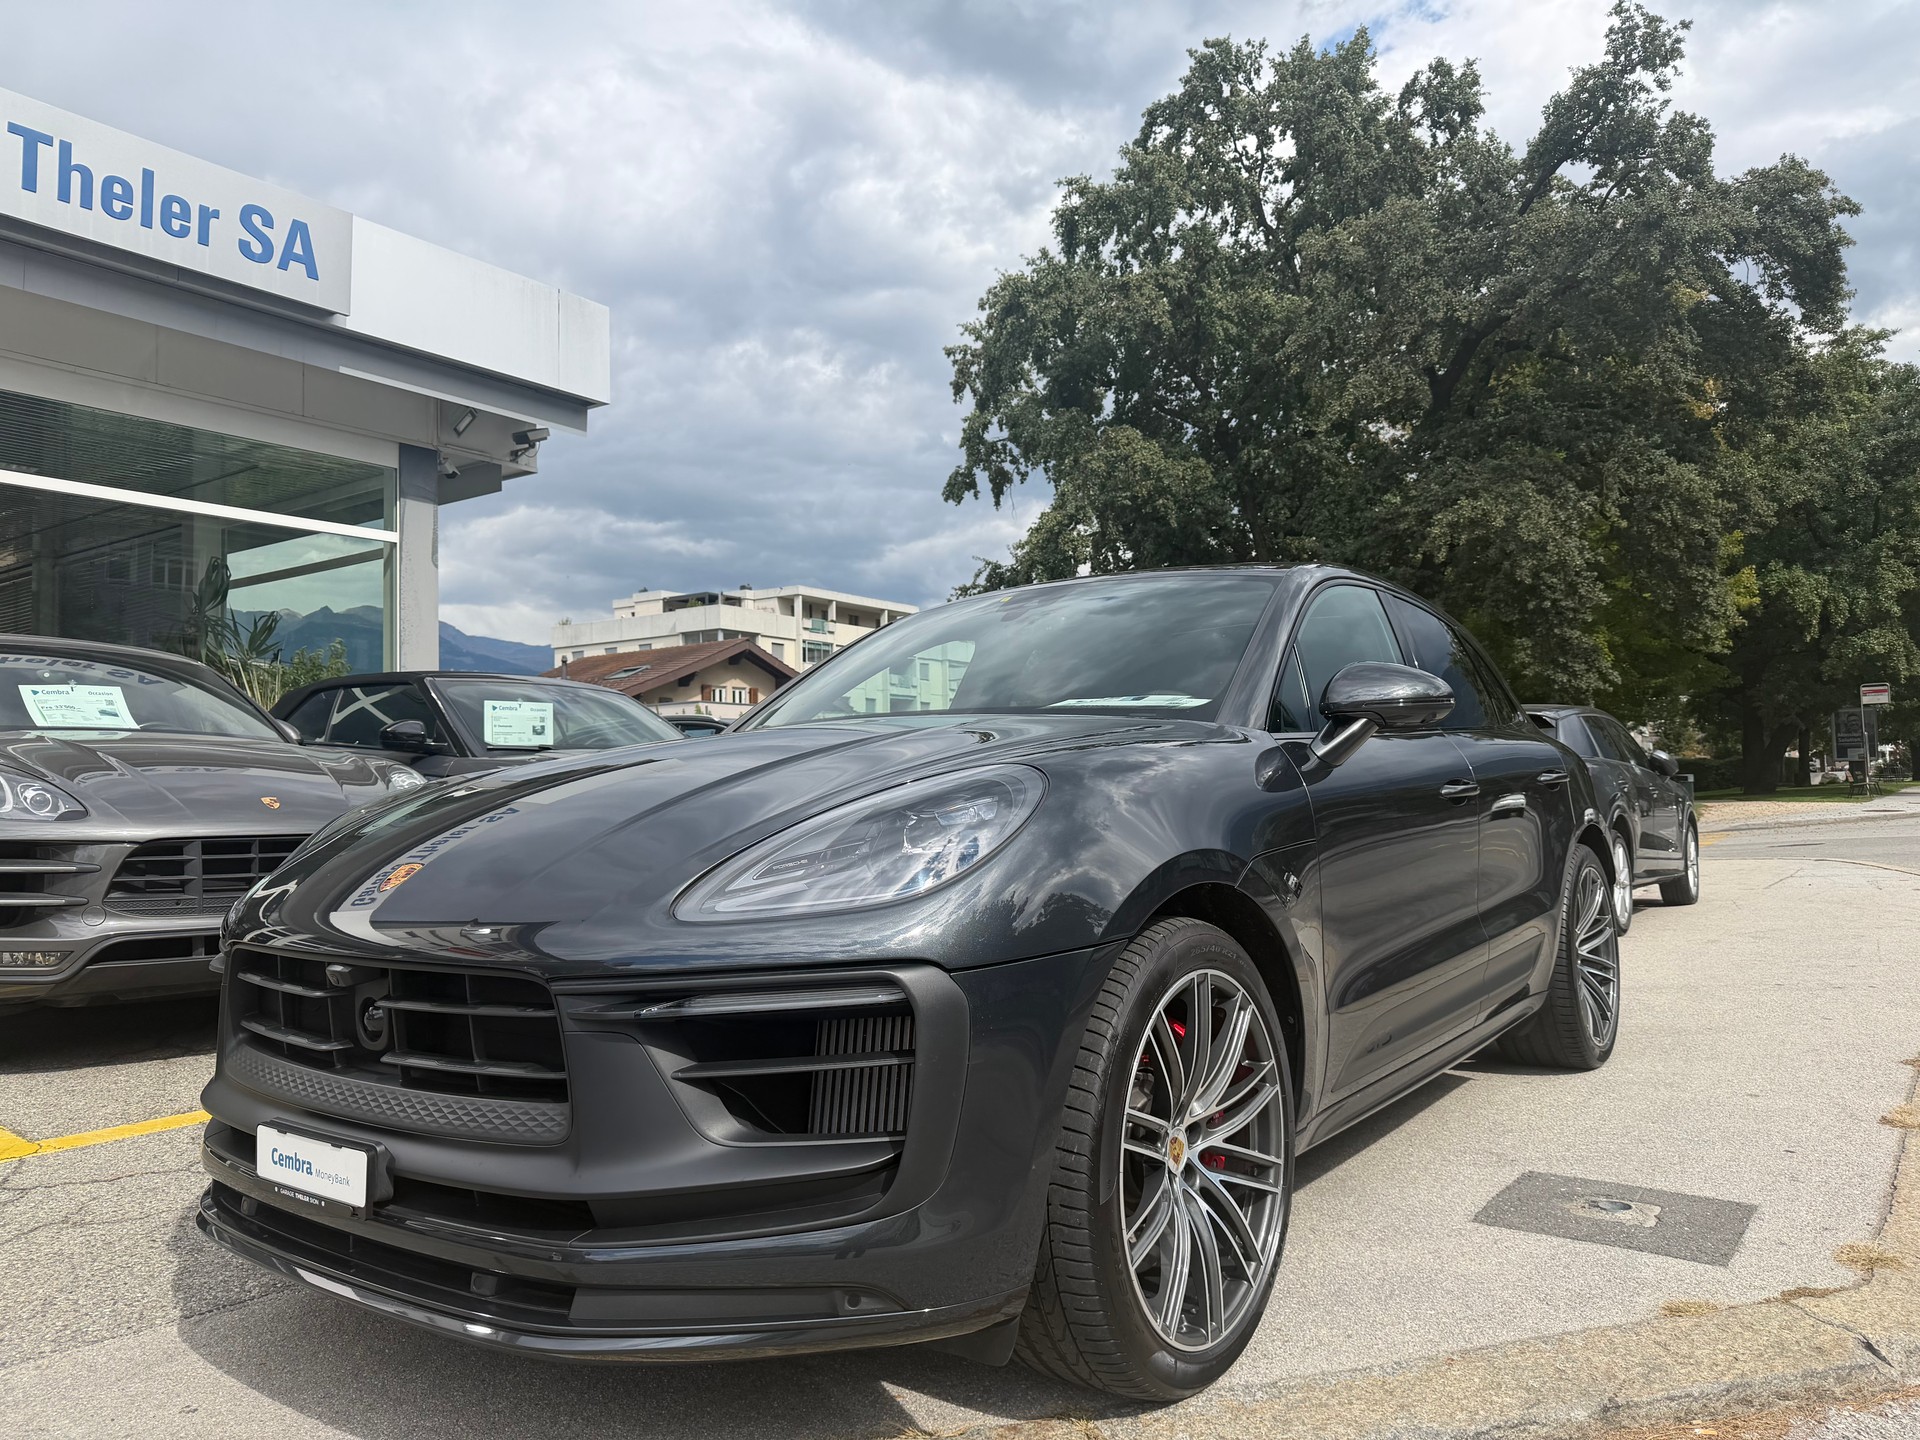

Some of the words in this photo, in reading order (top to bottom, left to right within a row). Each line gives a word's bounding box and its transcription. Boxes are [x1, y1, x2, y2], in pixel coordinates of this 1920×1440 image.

[7, 121, 220, 247] Theler
[237, 202, 320, 281] SA
[772, 859, 809, 870] PORSCHE
[271, 1147, 313, 1176] Cembra
[314, 1168, 350, 1187] MoneyBank
[280, 1188, 295, 1198] GARAGE
[295, 1192, 310, 1202] THELER
